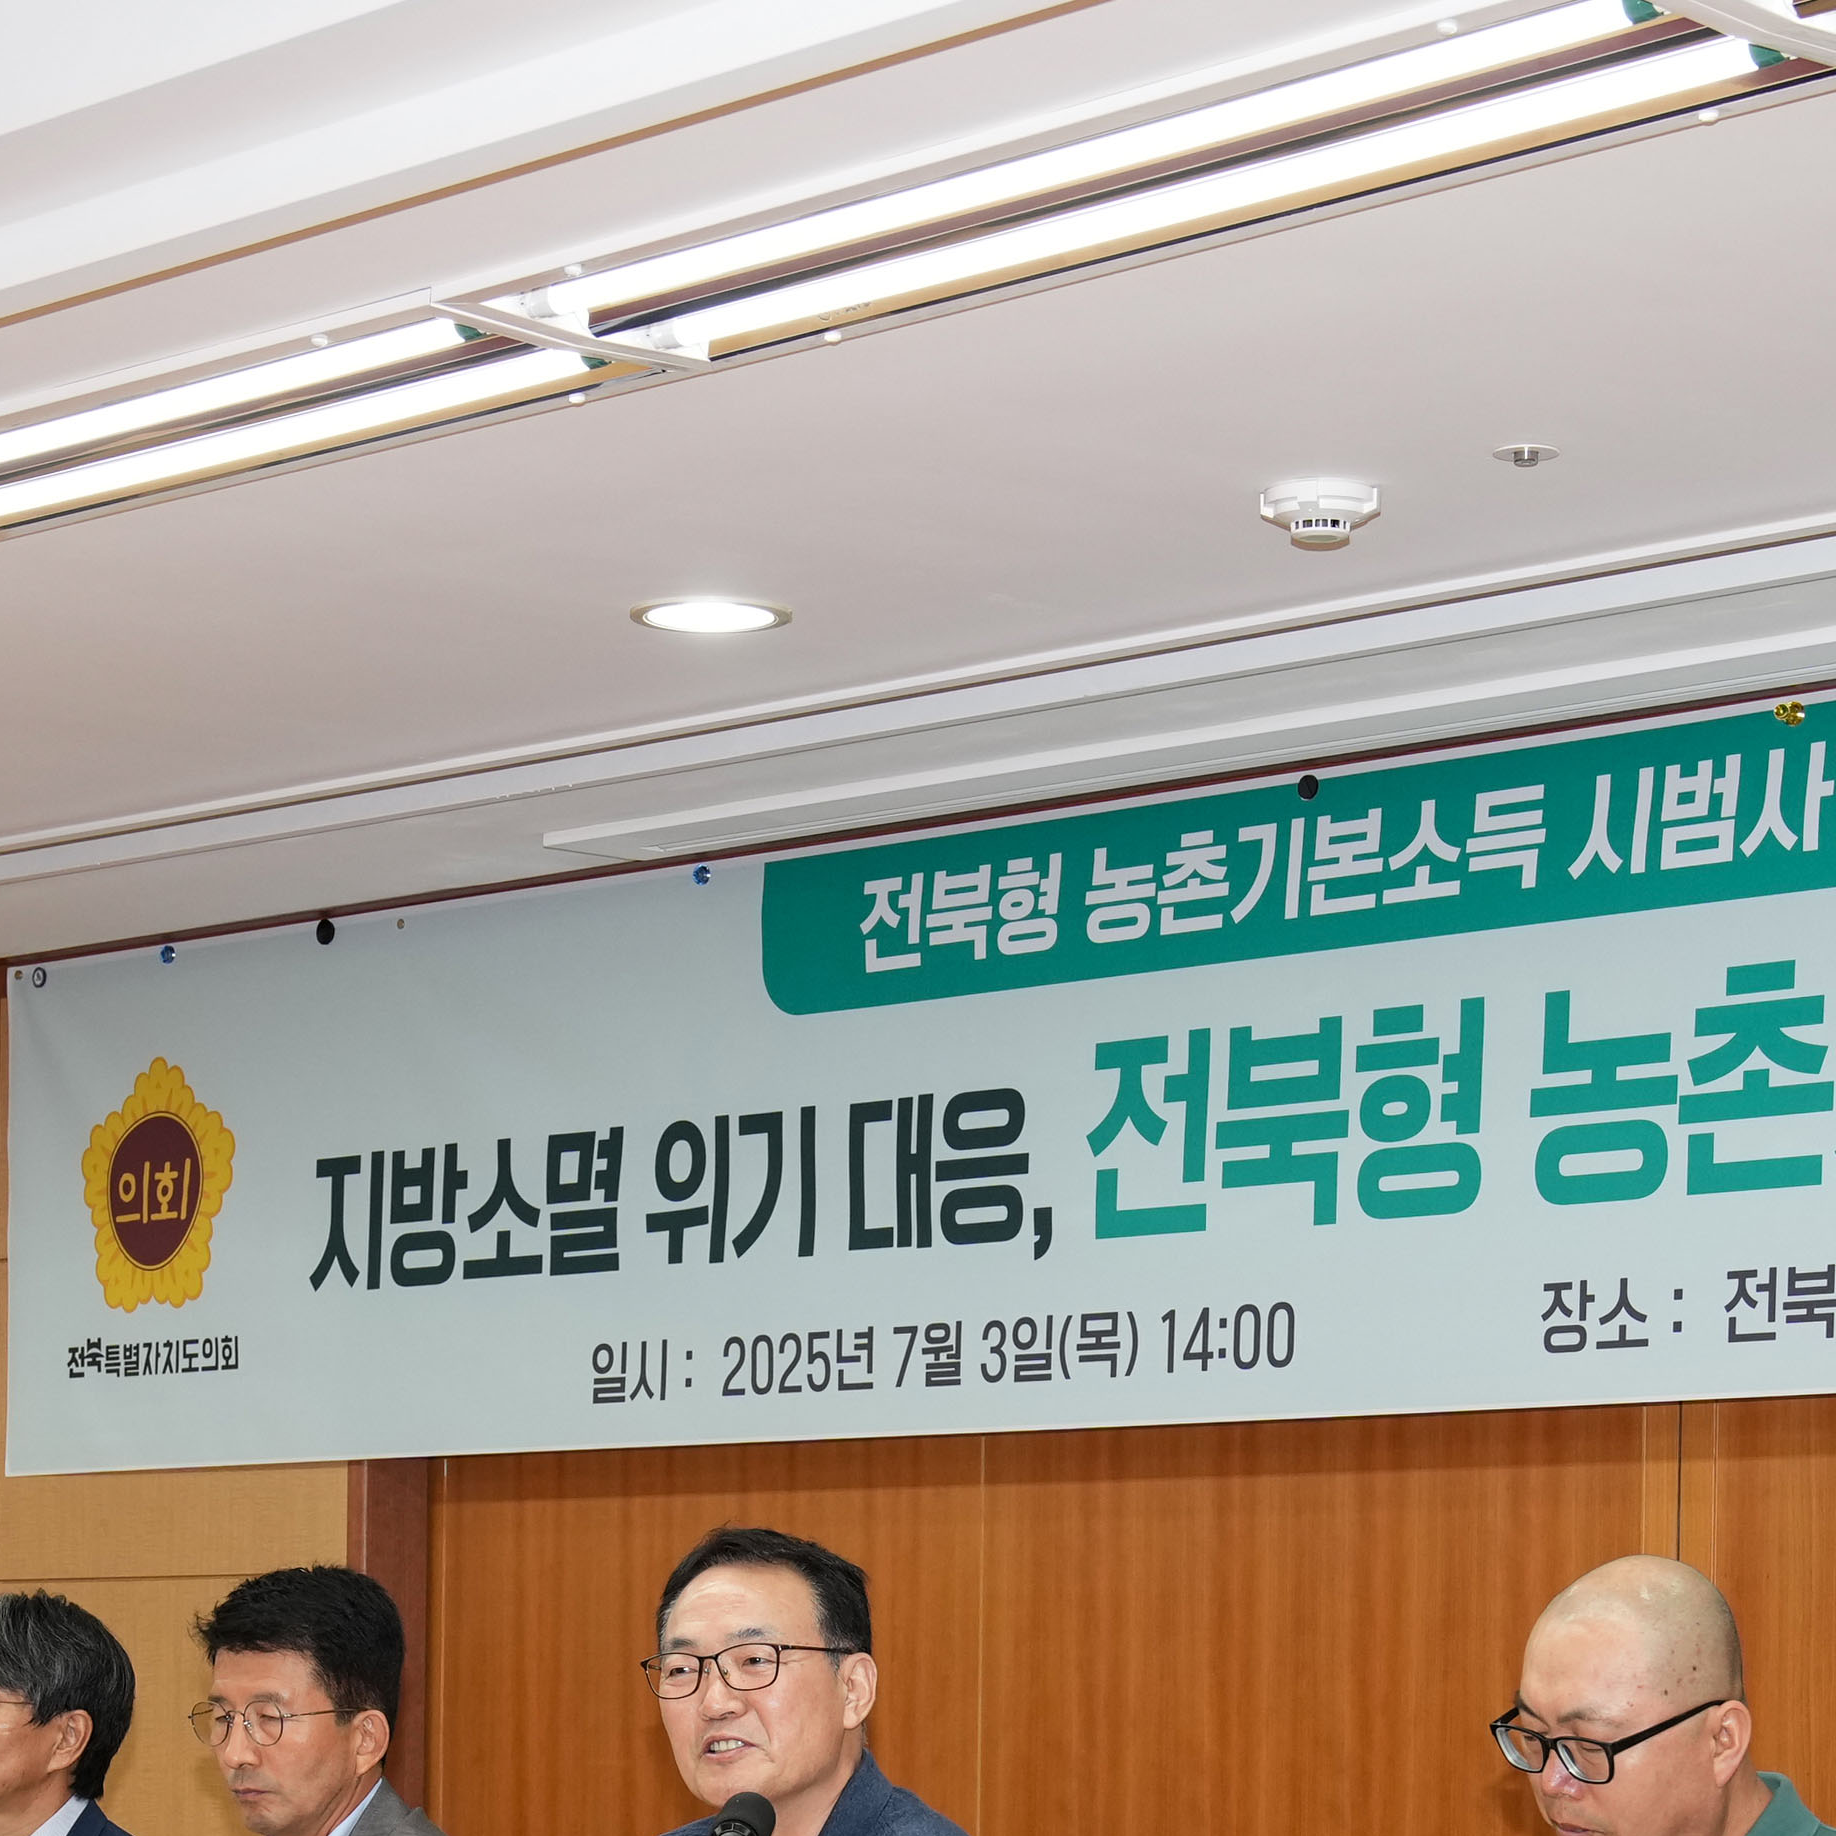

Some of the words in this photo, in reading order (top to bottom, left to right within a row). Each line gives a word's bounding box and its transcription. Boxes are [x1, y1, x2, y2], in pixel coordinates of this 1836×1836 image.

[860, 853, 1062, 973] 전북형
[1085, 784, 1546, 943] 농촌기본소득
[116, 1158, 190, 1223] 의회
[309, 1126, 624, 1291] 지방소멸
[646, 1106, 816, 1264] 위기
[849, 1088, 1052, 1260] 대응,
[1086, 997, 1484, 1239] 전북형
[67, 1335, 238, 1378] 전북특별자치도의회
[722, 1326, 873, 1396] 2025년
[893, 1321, 962, 1387] 7월
[981, 1311, 1138, 1383] 3일(목)
[1162, 1302, 1294, 1373] 14:00
